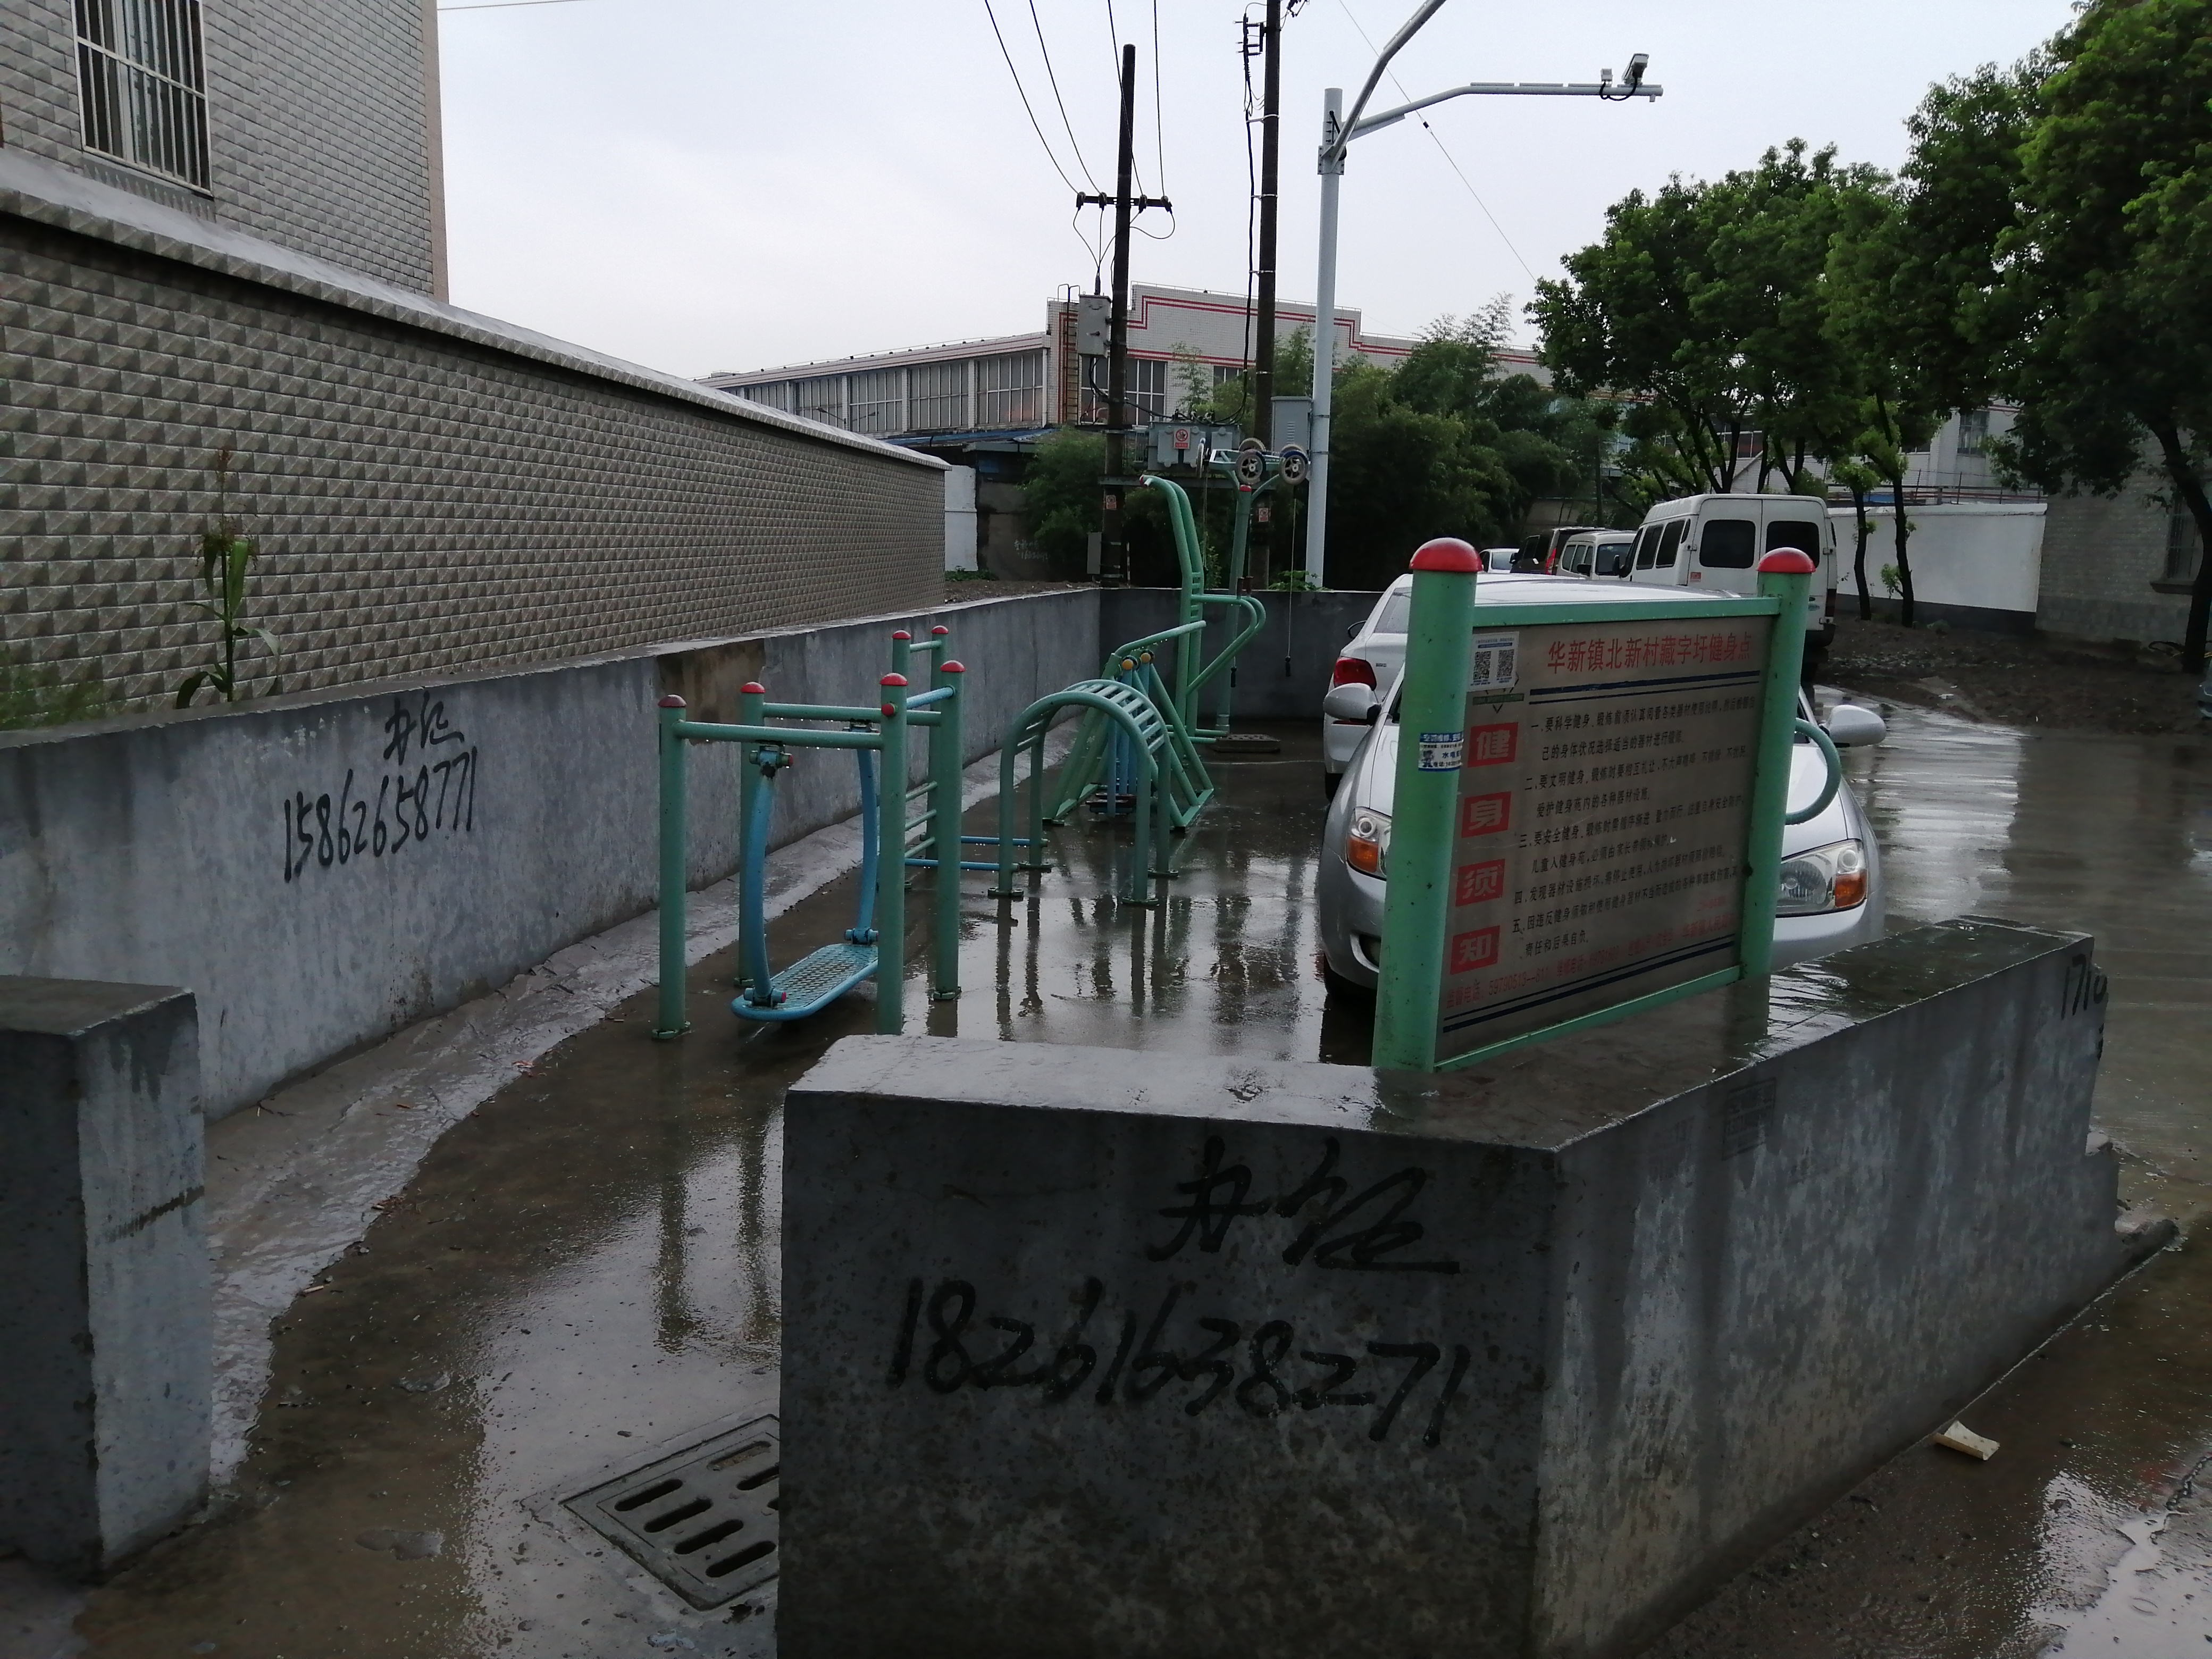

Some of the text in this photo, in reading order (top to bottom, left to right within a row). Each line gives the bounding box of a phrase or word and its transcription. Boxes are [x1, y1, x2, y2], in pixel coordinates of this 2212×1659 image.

[1547, 631, 1752, 674] 华新镇北新村藏字圩健身点
[284, 746, 478, 883] 15862658771
